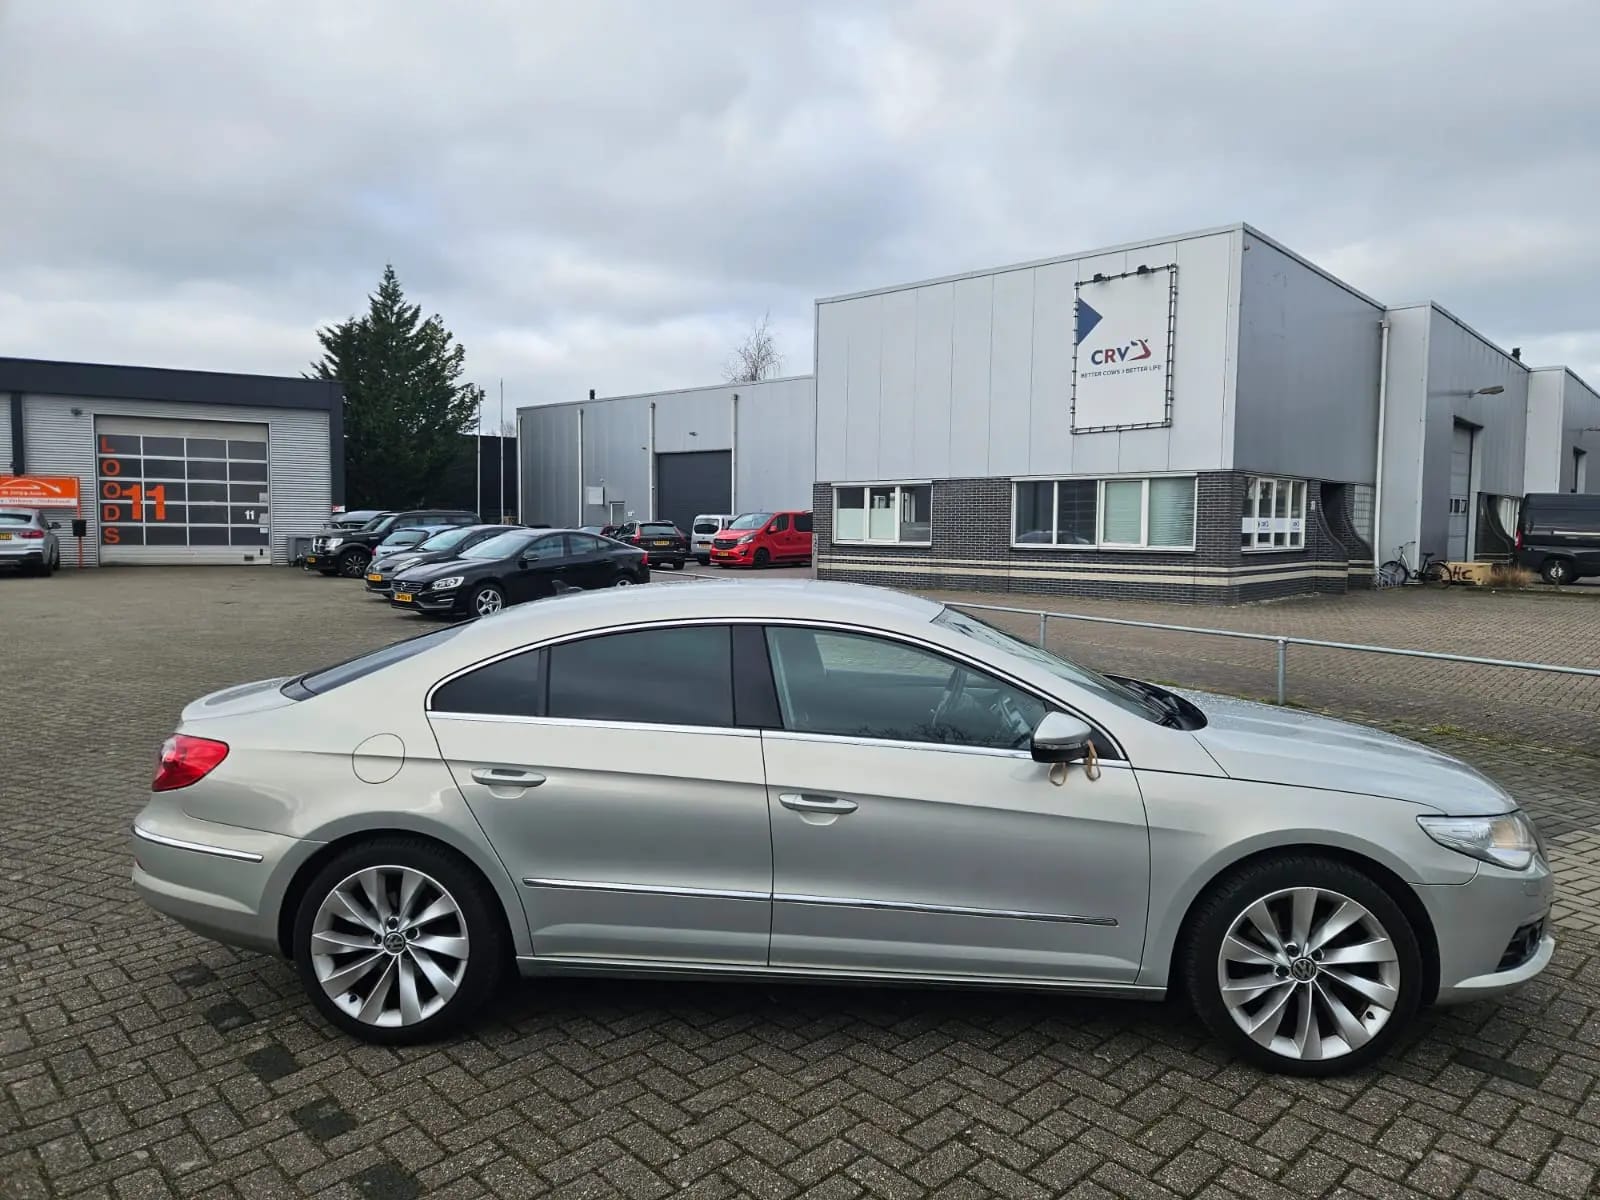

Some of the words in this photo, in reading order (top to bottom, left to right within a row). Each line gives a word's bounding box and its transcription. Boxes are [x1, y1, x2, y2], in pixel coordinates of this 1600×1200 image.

[1091, 346, 1130, 365] CRV
[1126, 366, 1148, 374] BETTER
[122, 484, 166, 520] 11
[244, 510, 255, 520] 11
